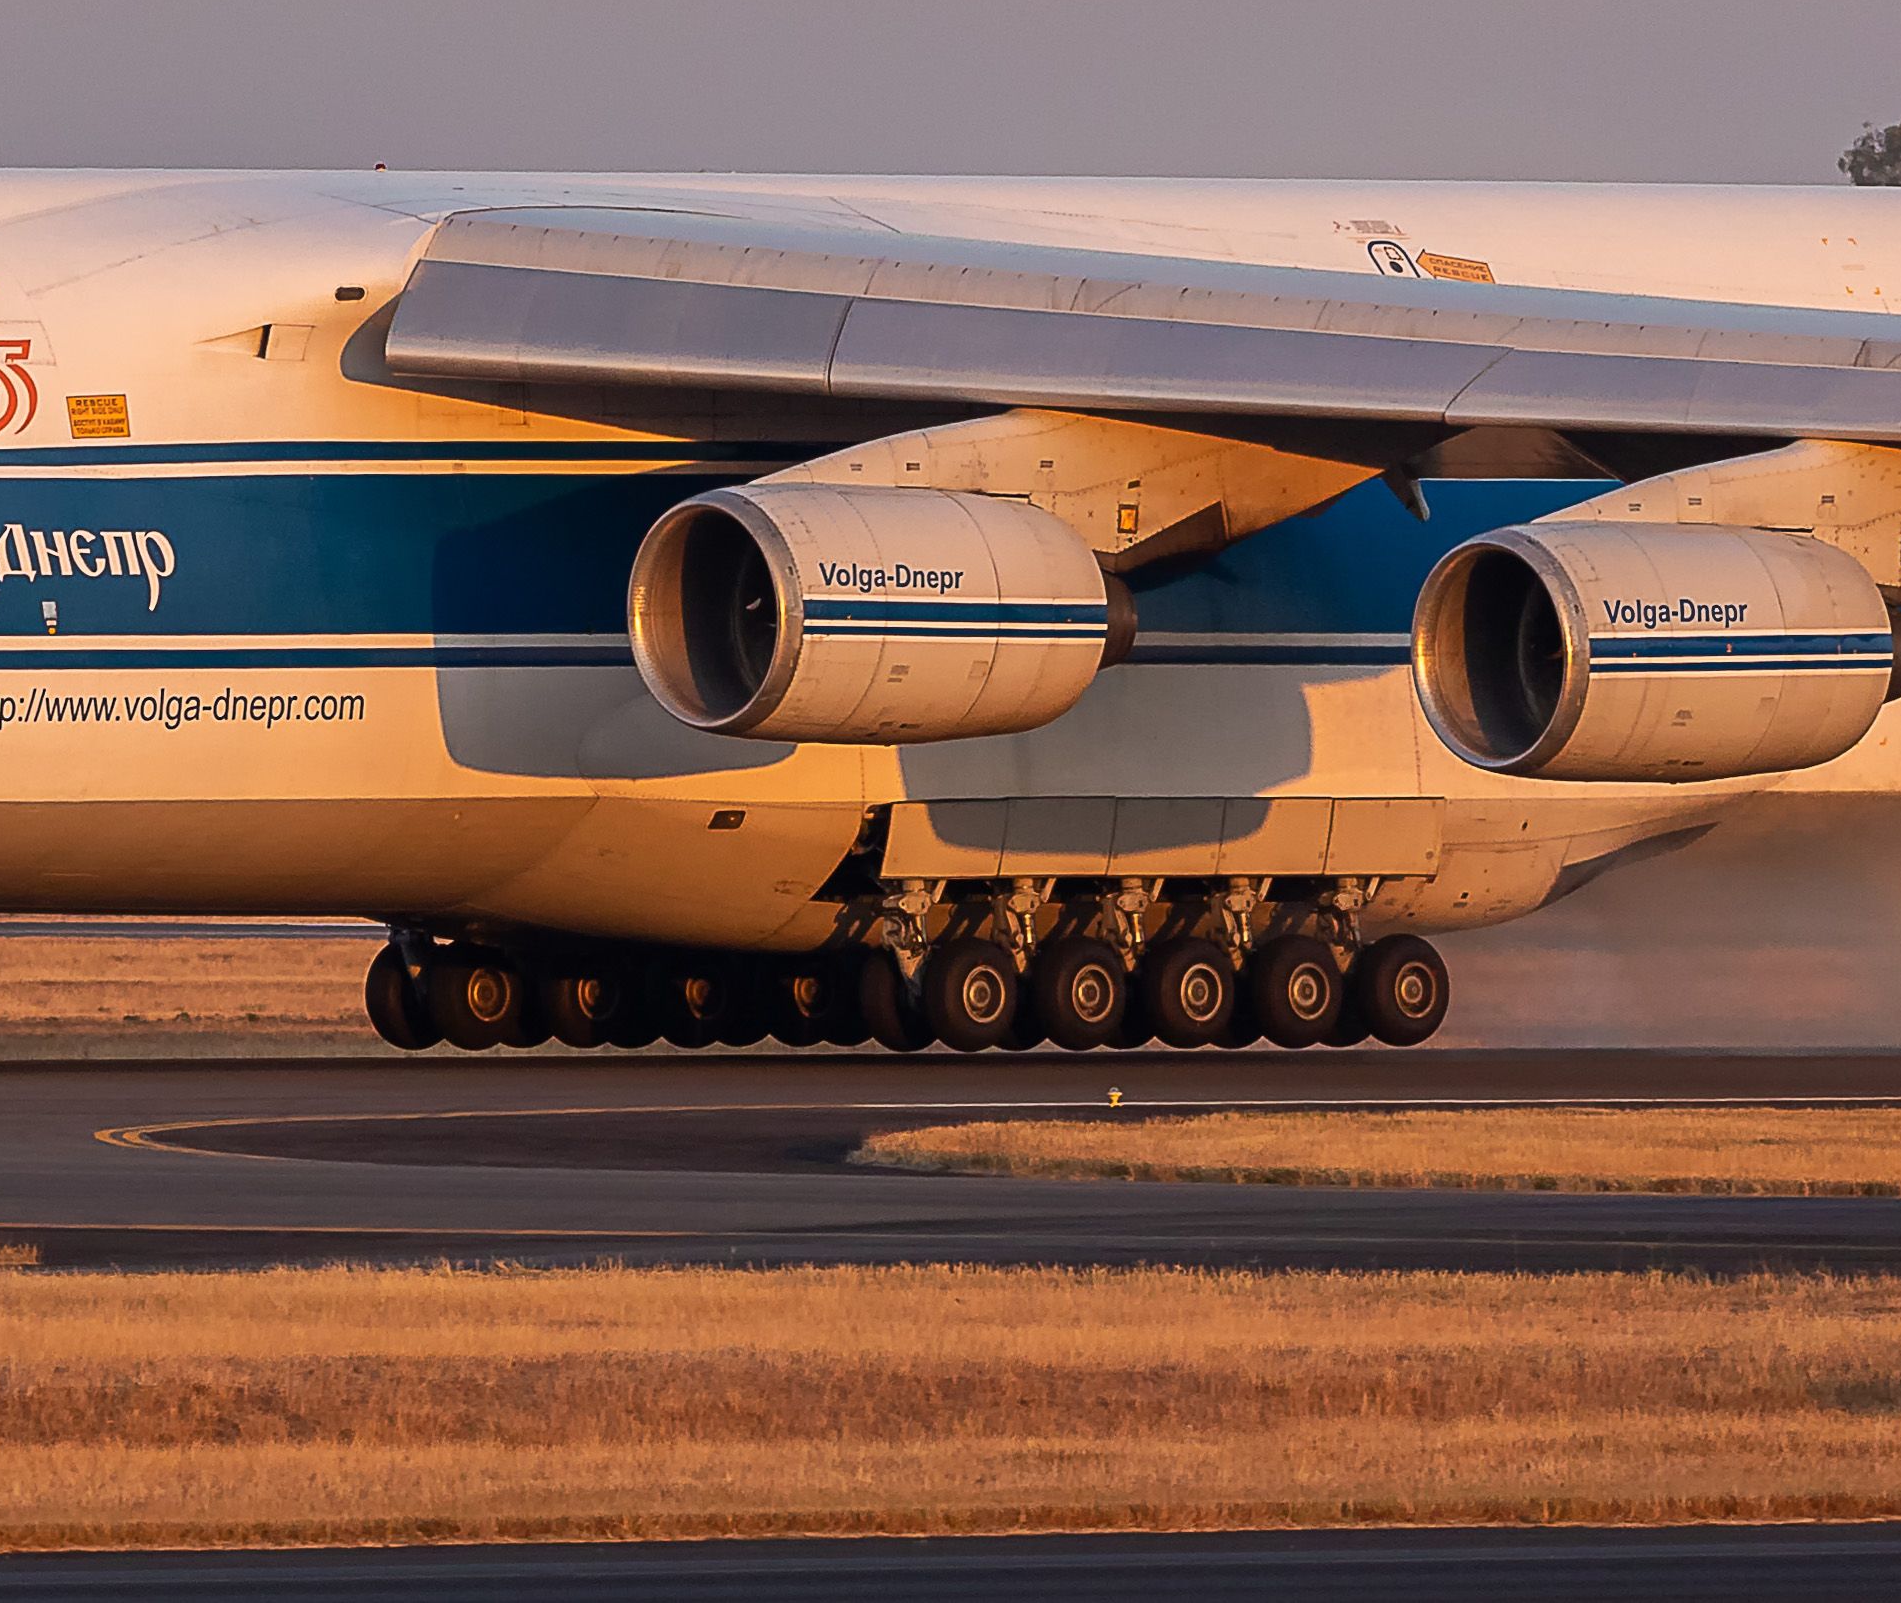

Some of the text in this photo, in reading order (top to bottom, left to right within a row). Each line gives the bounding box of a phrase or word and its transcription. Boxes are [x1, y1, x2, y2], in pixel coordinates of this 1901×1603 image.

[1433, 265, 1490, 281] RESCUE
[818, 562, 964, 595] Volga-Dnepr
[1603, 598, 1748, 630] Volga-Dnepr
